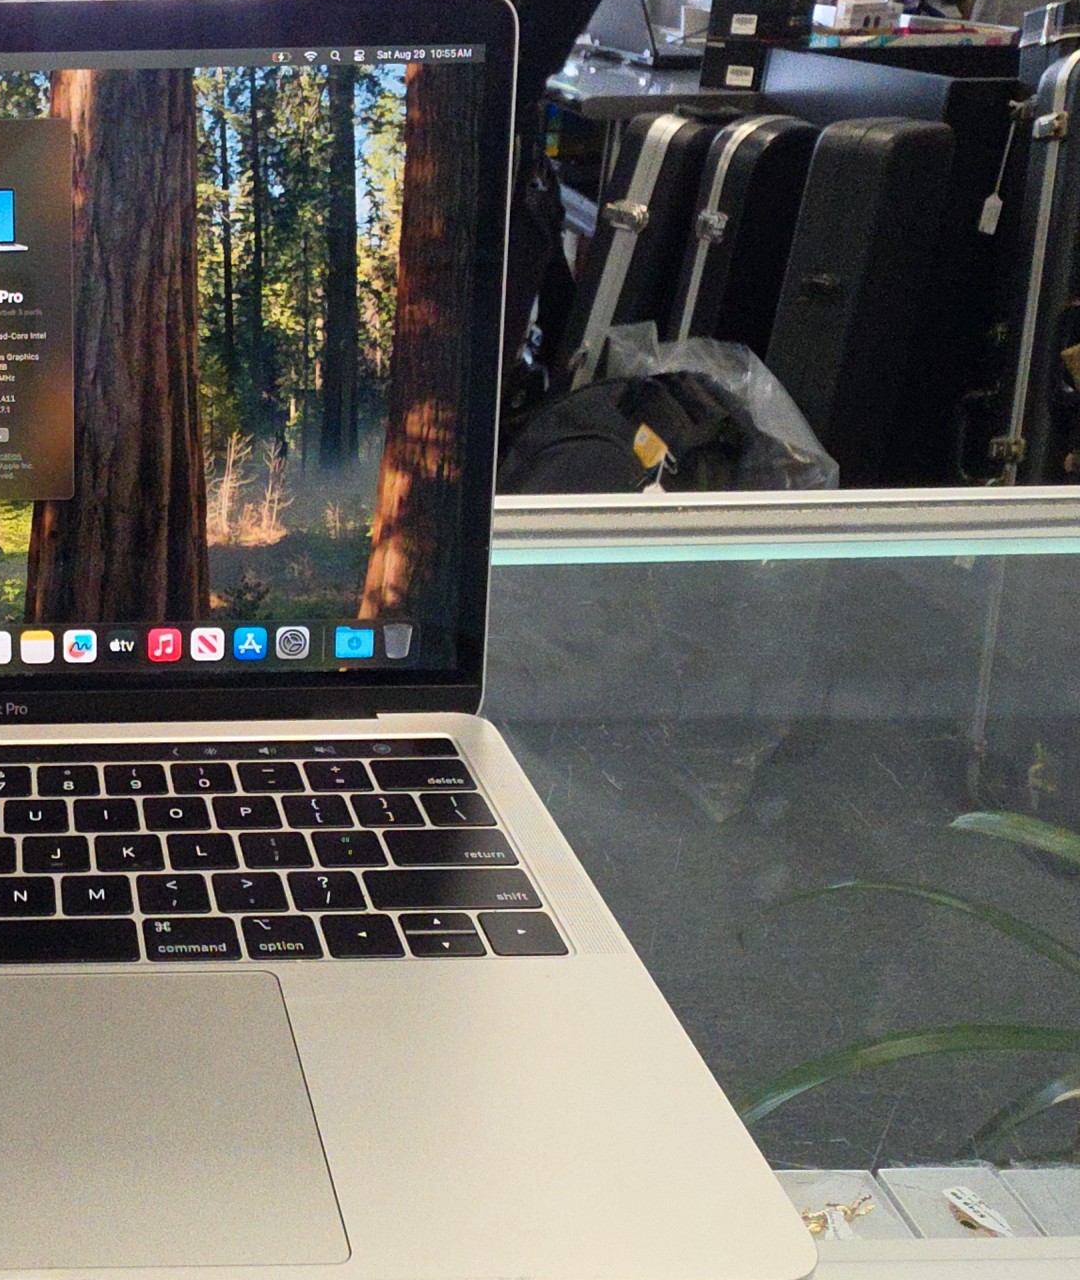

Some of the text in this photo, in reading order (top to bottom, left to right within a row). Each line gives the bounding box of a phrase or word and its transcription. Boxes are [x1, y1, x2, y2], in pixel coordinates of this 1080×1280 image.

[377, 50, 392, 59] Sat
[395, 49, 411, 60] Aug
[414, 49, 425, 59] 29
[30, 332, 46, 340] Intel
[6, 353, 39, 362] Graphics
[6, 702, 29, 716] Pro
[63, 781, 74, 790] 8
[131, 780, 141, 788] 9
[29, 811, 42, 821] U
[104, 810, 108, 819] I
[170, 808, 182, 818] O
[240, 807, 251, 816] P
[51, 848, 60, 859] J
[123, 847, 134, 857] K
[196, 846, 207, 856] L
[464, 850, 505, 859] return
[166, 881, 177, 889] <
[241, 879, 252, 888] >
[317, 876, 328, 888] ?
[14, 891, 27, 901] N
[89, 889, 105, 899] M
[496, 892, 528, 901] shift
[158, 943, 226, 952] command
[260, 942, 304, 951] option
